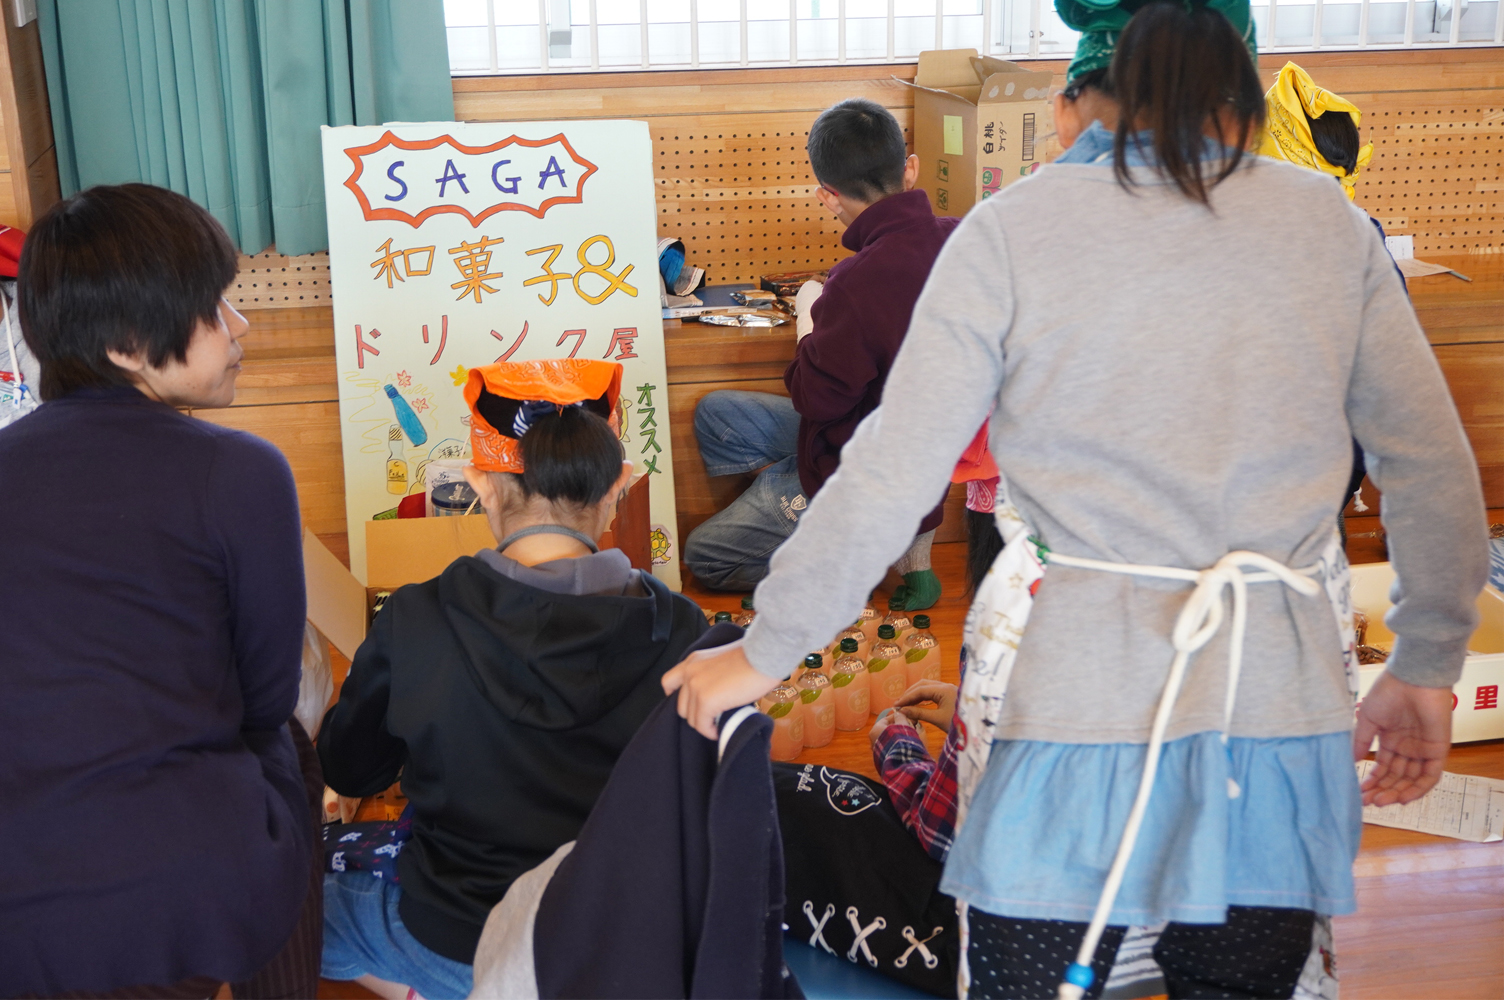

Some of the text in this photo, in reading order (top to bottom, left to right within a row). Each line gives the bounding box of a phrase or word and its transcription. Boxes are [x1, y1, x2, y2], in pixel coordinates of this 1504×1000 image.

[982, 121, 995, 154] 白桃
[384, 155, 568, 202] SAGA
[370, 234, 639, 307] 和菓子&
[355, 315, 639, 369] ドリンク屋
[636, 383, 662, 476] オススメ
